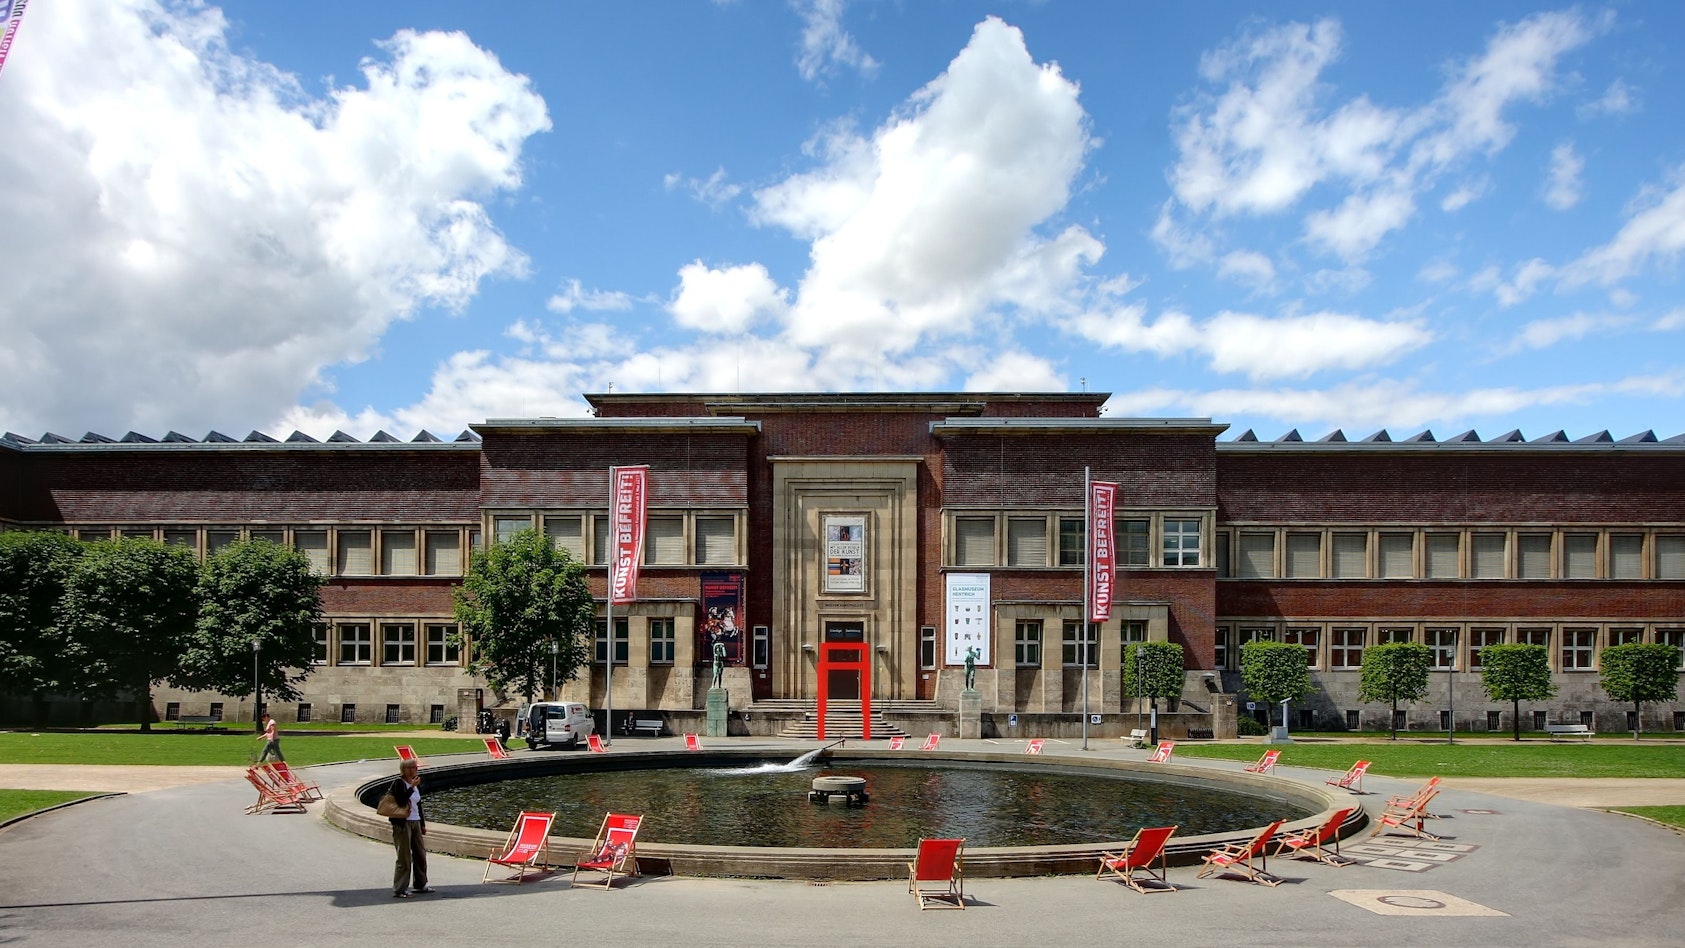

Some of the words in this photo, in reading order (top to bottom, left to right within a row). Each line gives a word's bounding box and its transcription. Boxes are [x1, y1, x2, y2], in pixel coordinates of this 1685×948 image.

[619, 475, 633, 543] BEFREIT!
[1096, 489, 1108, 557] BEFREIT!
[614, 547, 632, 598] KUNST
[1096, 562, 1109, 613] KUNST
